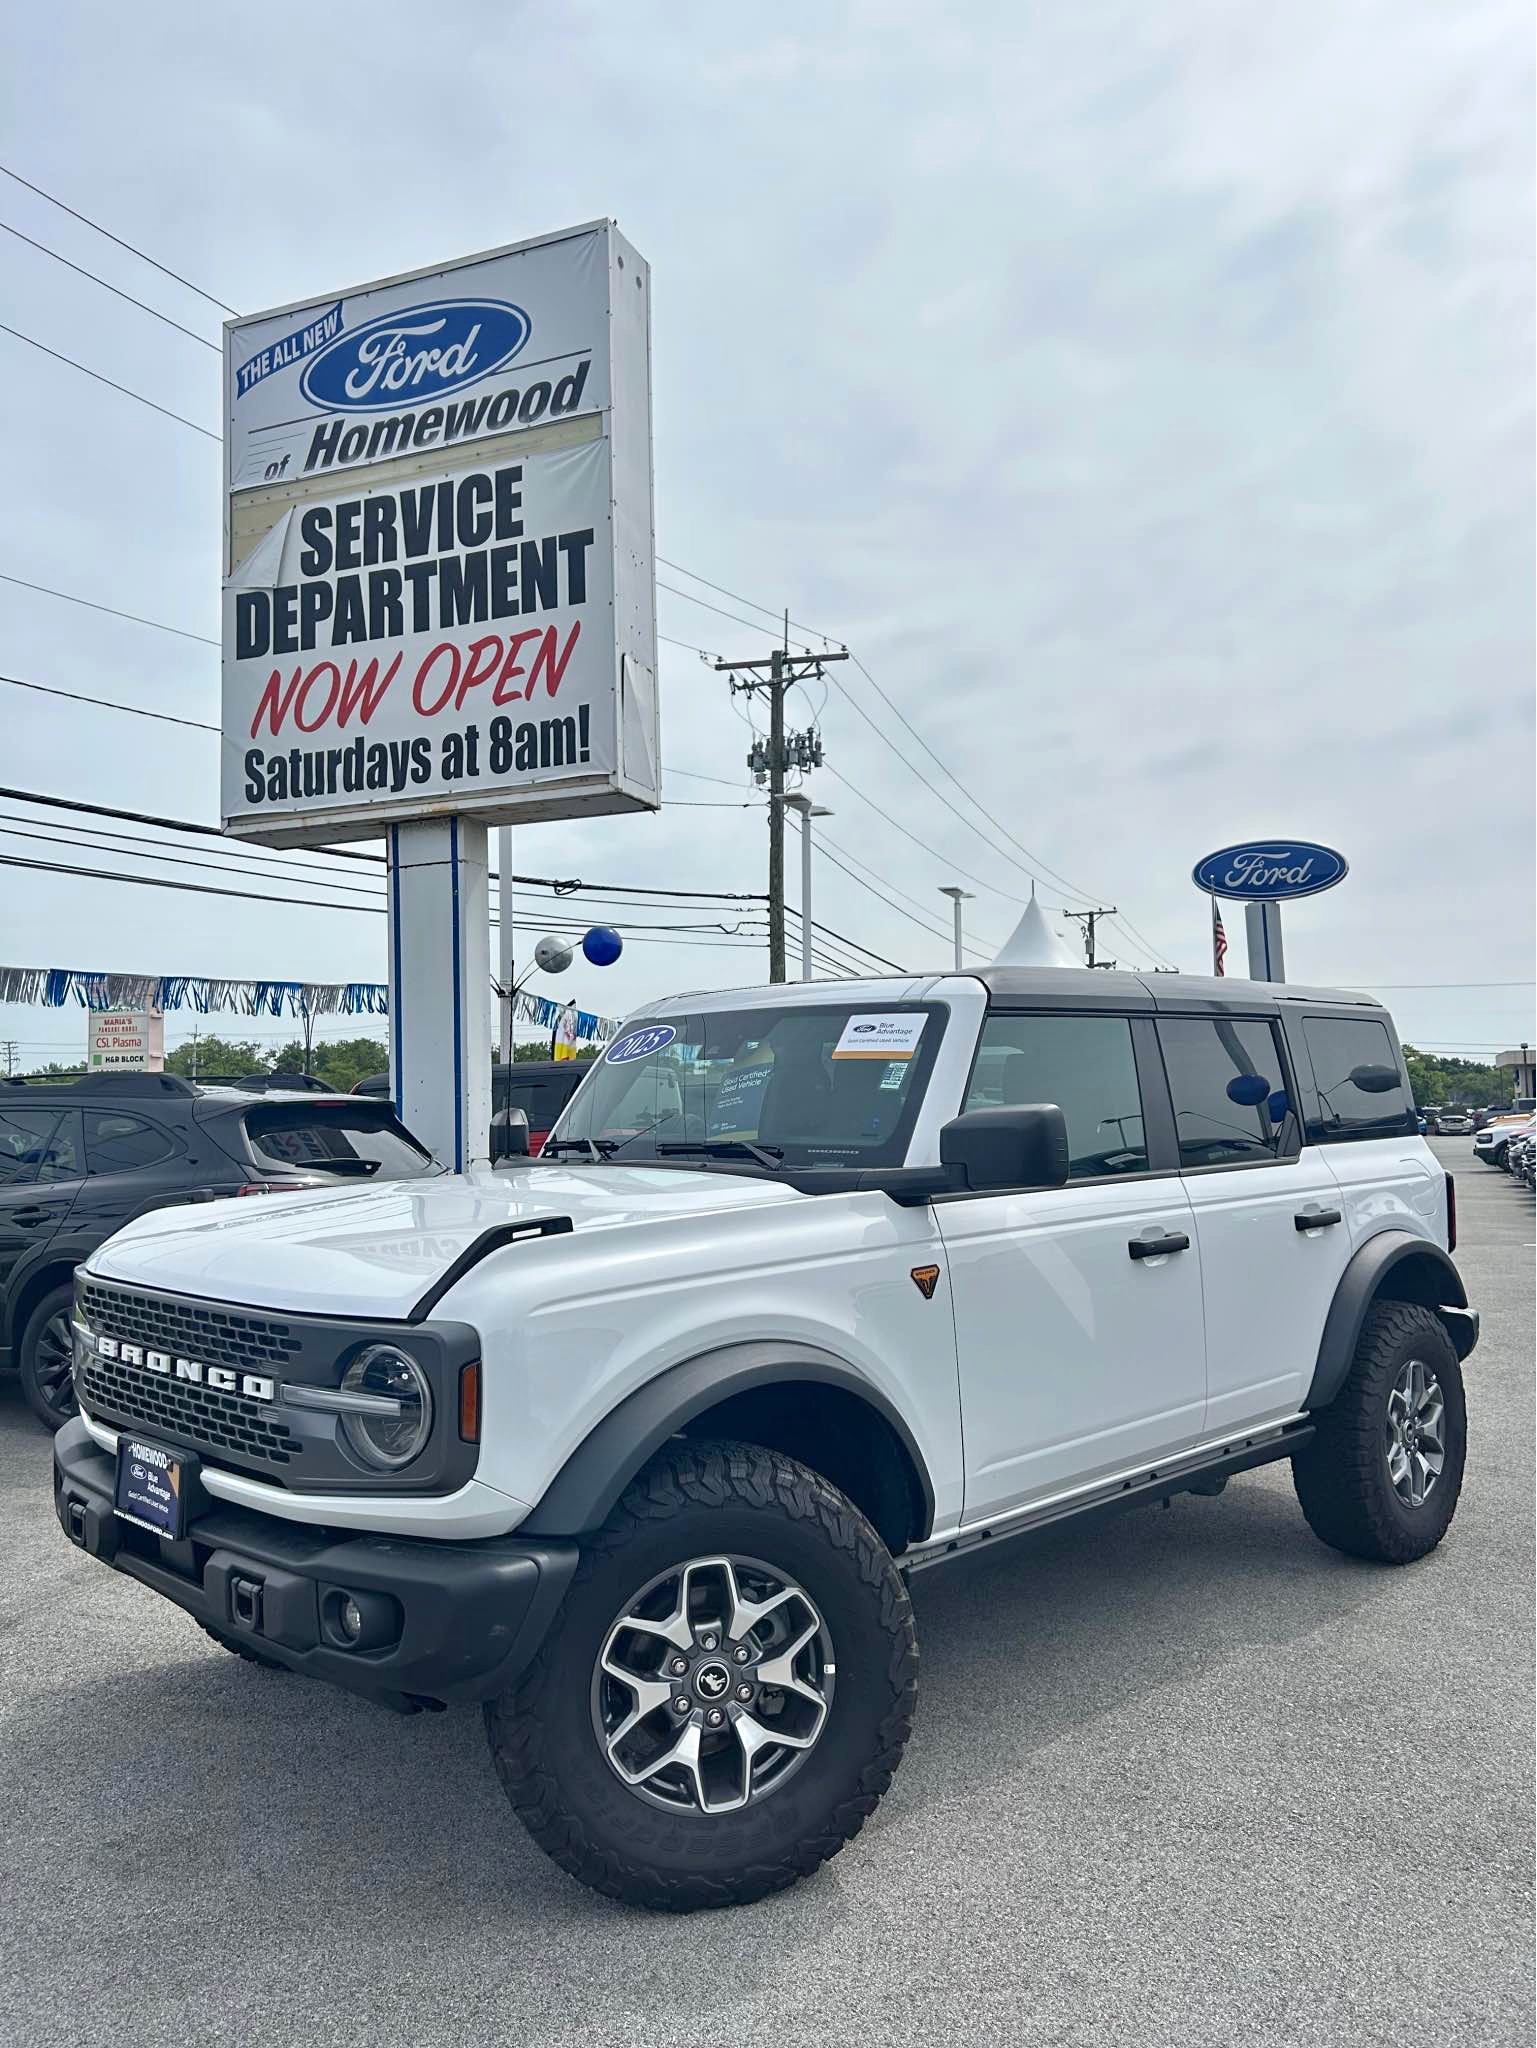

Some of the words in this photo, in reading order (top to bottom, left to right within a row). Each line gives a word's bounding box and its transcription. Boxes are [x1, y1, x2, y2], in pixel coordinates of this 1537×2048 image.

[241, 351, 270, 390] THE
[273, 337, 301, 369] ALL
[303, 309, 338, 353] NEW
[345, 318, 482, 399] Ford
[264, 454, 291, 481] of
[304, 360, 591, 471] Homewood
[300, 465, 524, 577] SERVICE
[236, 528, 594, 660] DEPARTMENT
[250, 649, 403, 739] NOW
[412, 619, 581, 717] OPEN
[244, 736, 432, 804] Saturdays
[441, 723, 479, 781] at
[489, 703, 591, 775] 8am!
[1224, 851, 1314, 887] Ford
[96, 1037, 111, 1048] CSL
[112, 1036, 142, 1047] Plasma
[121, 1055, 144, 1063] BLOCK
[611, 1029, 668, 1060] 2025
[98, 1336, 274, 1400] BRONCO
[131, 1441, 168, 1470] HOMEWOOD
